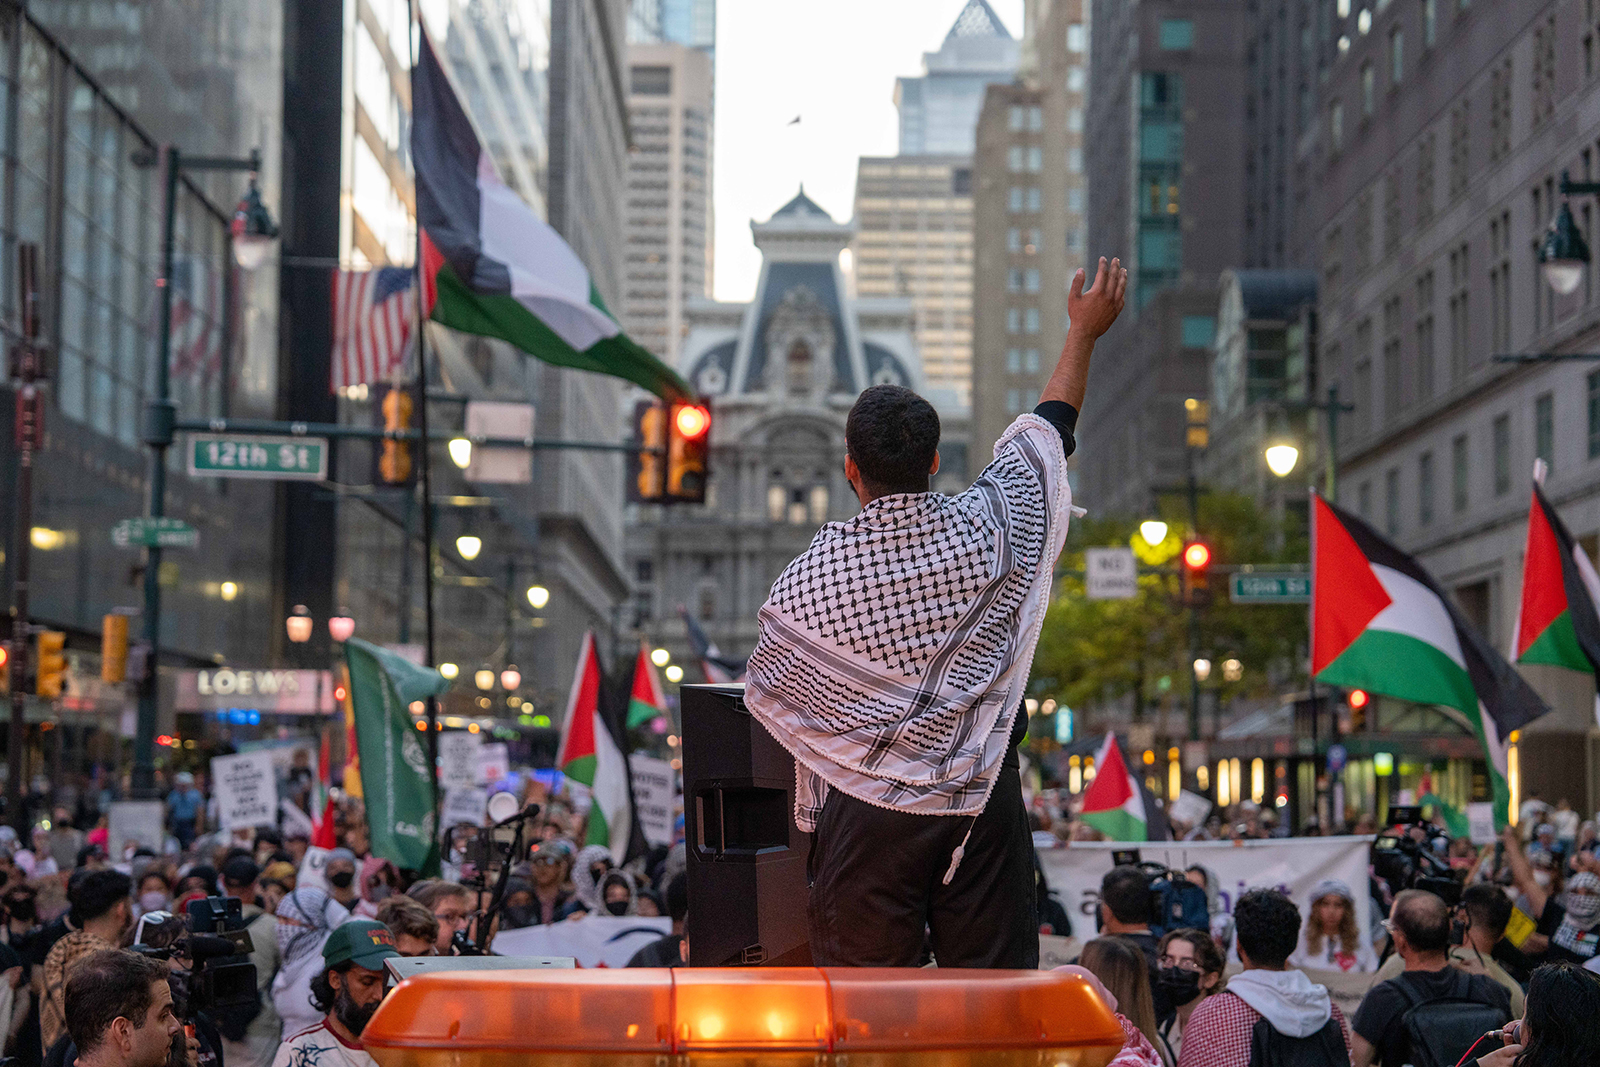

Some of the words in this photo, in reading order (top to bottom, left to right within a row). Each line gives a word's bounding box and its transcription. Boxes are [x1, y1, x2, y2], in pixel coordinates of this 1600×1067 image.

[207, 441, 267, 468] 12th
[279, 443, 309, 469] St
[1099, 556, 1124, 570] NO
[198, 669, 300, 695] LOEWS
